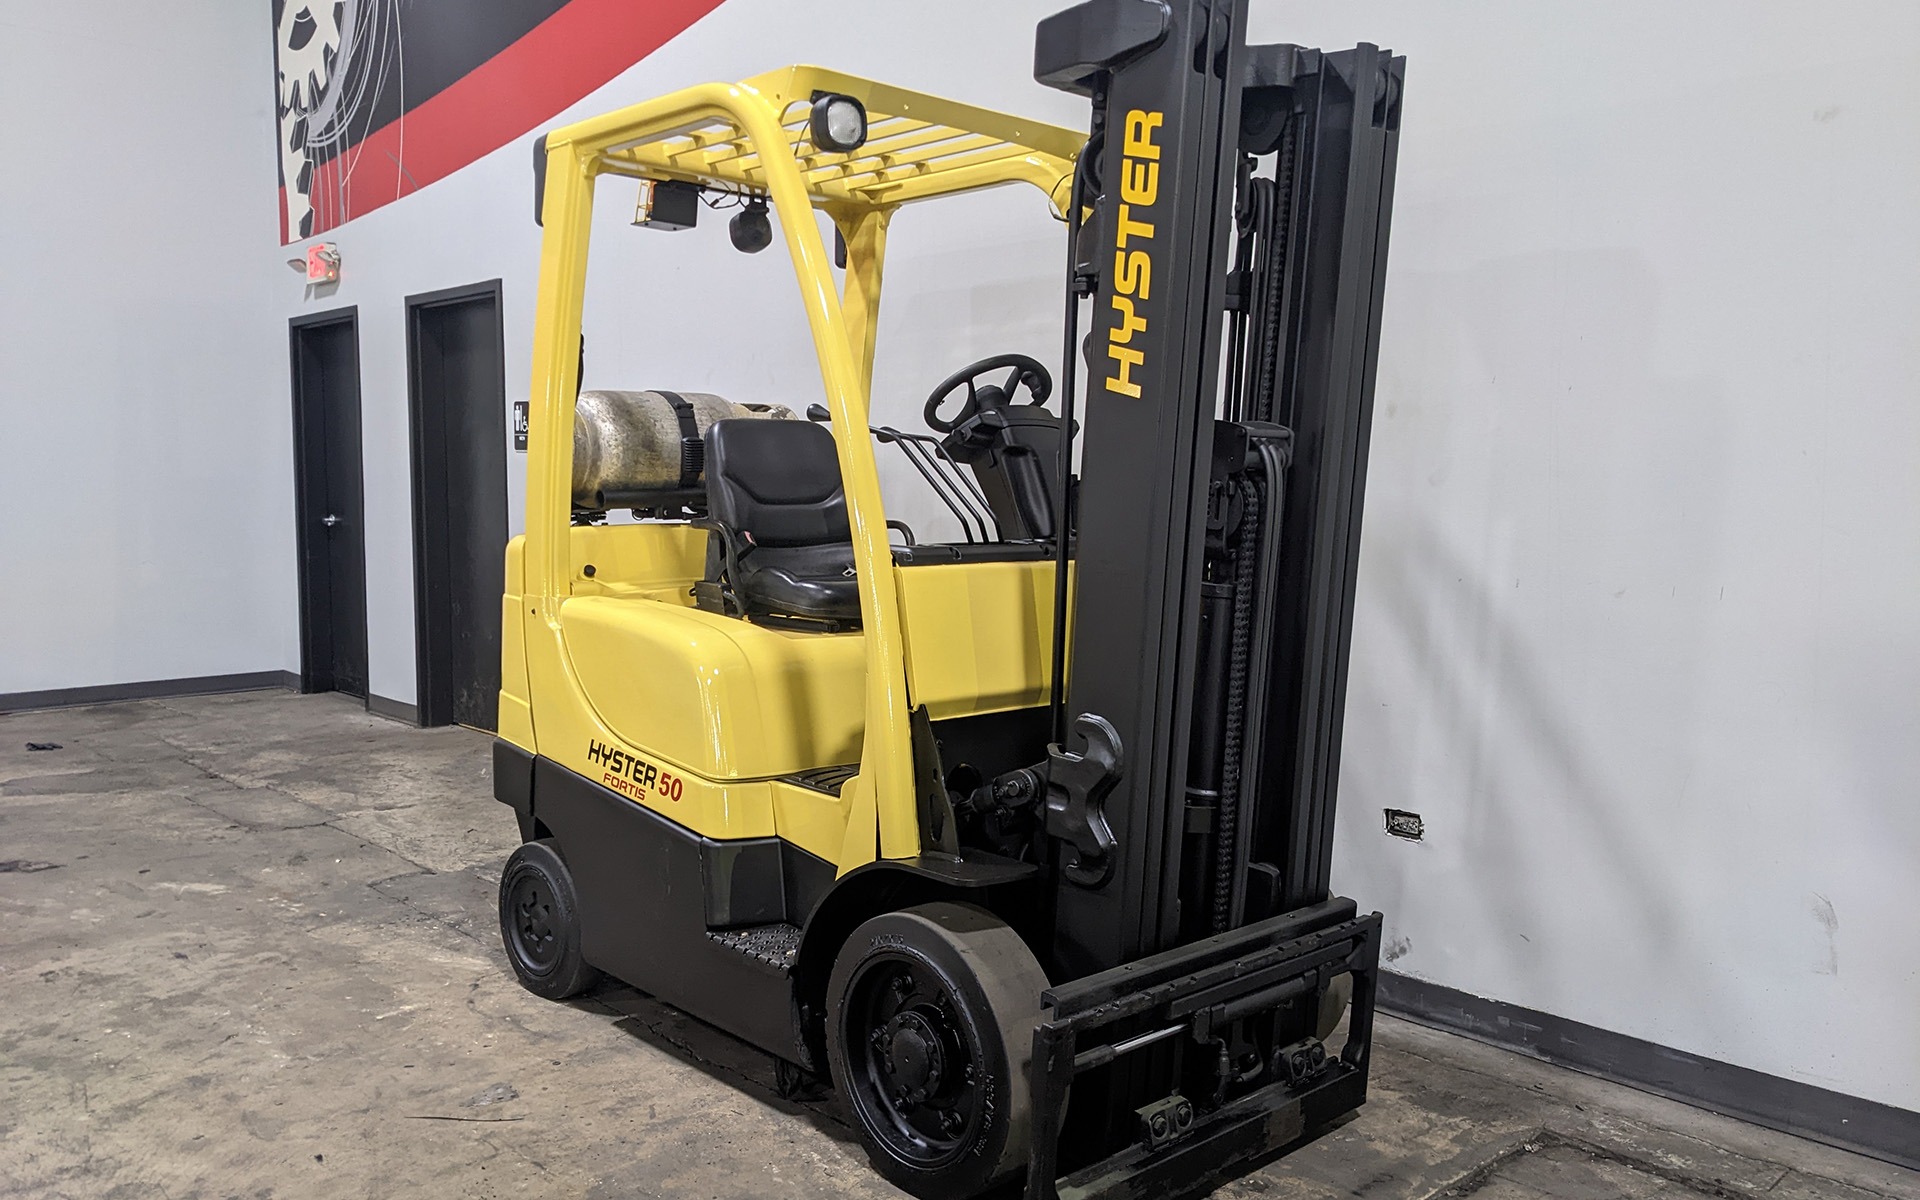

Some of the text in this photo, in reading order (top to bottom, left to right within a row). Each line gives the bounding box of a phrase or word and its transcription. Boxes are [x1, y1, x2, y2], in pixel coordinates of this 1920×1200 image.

[1106, 109, 1163, 399] HYSTER
[588, 739, 682, 801] HYSTER 50
[603, 773, 646, 800] FORTIS
